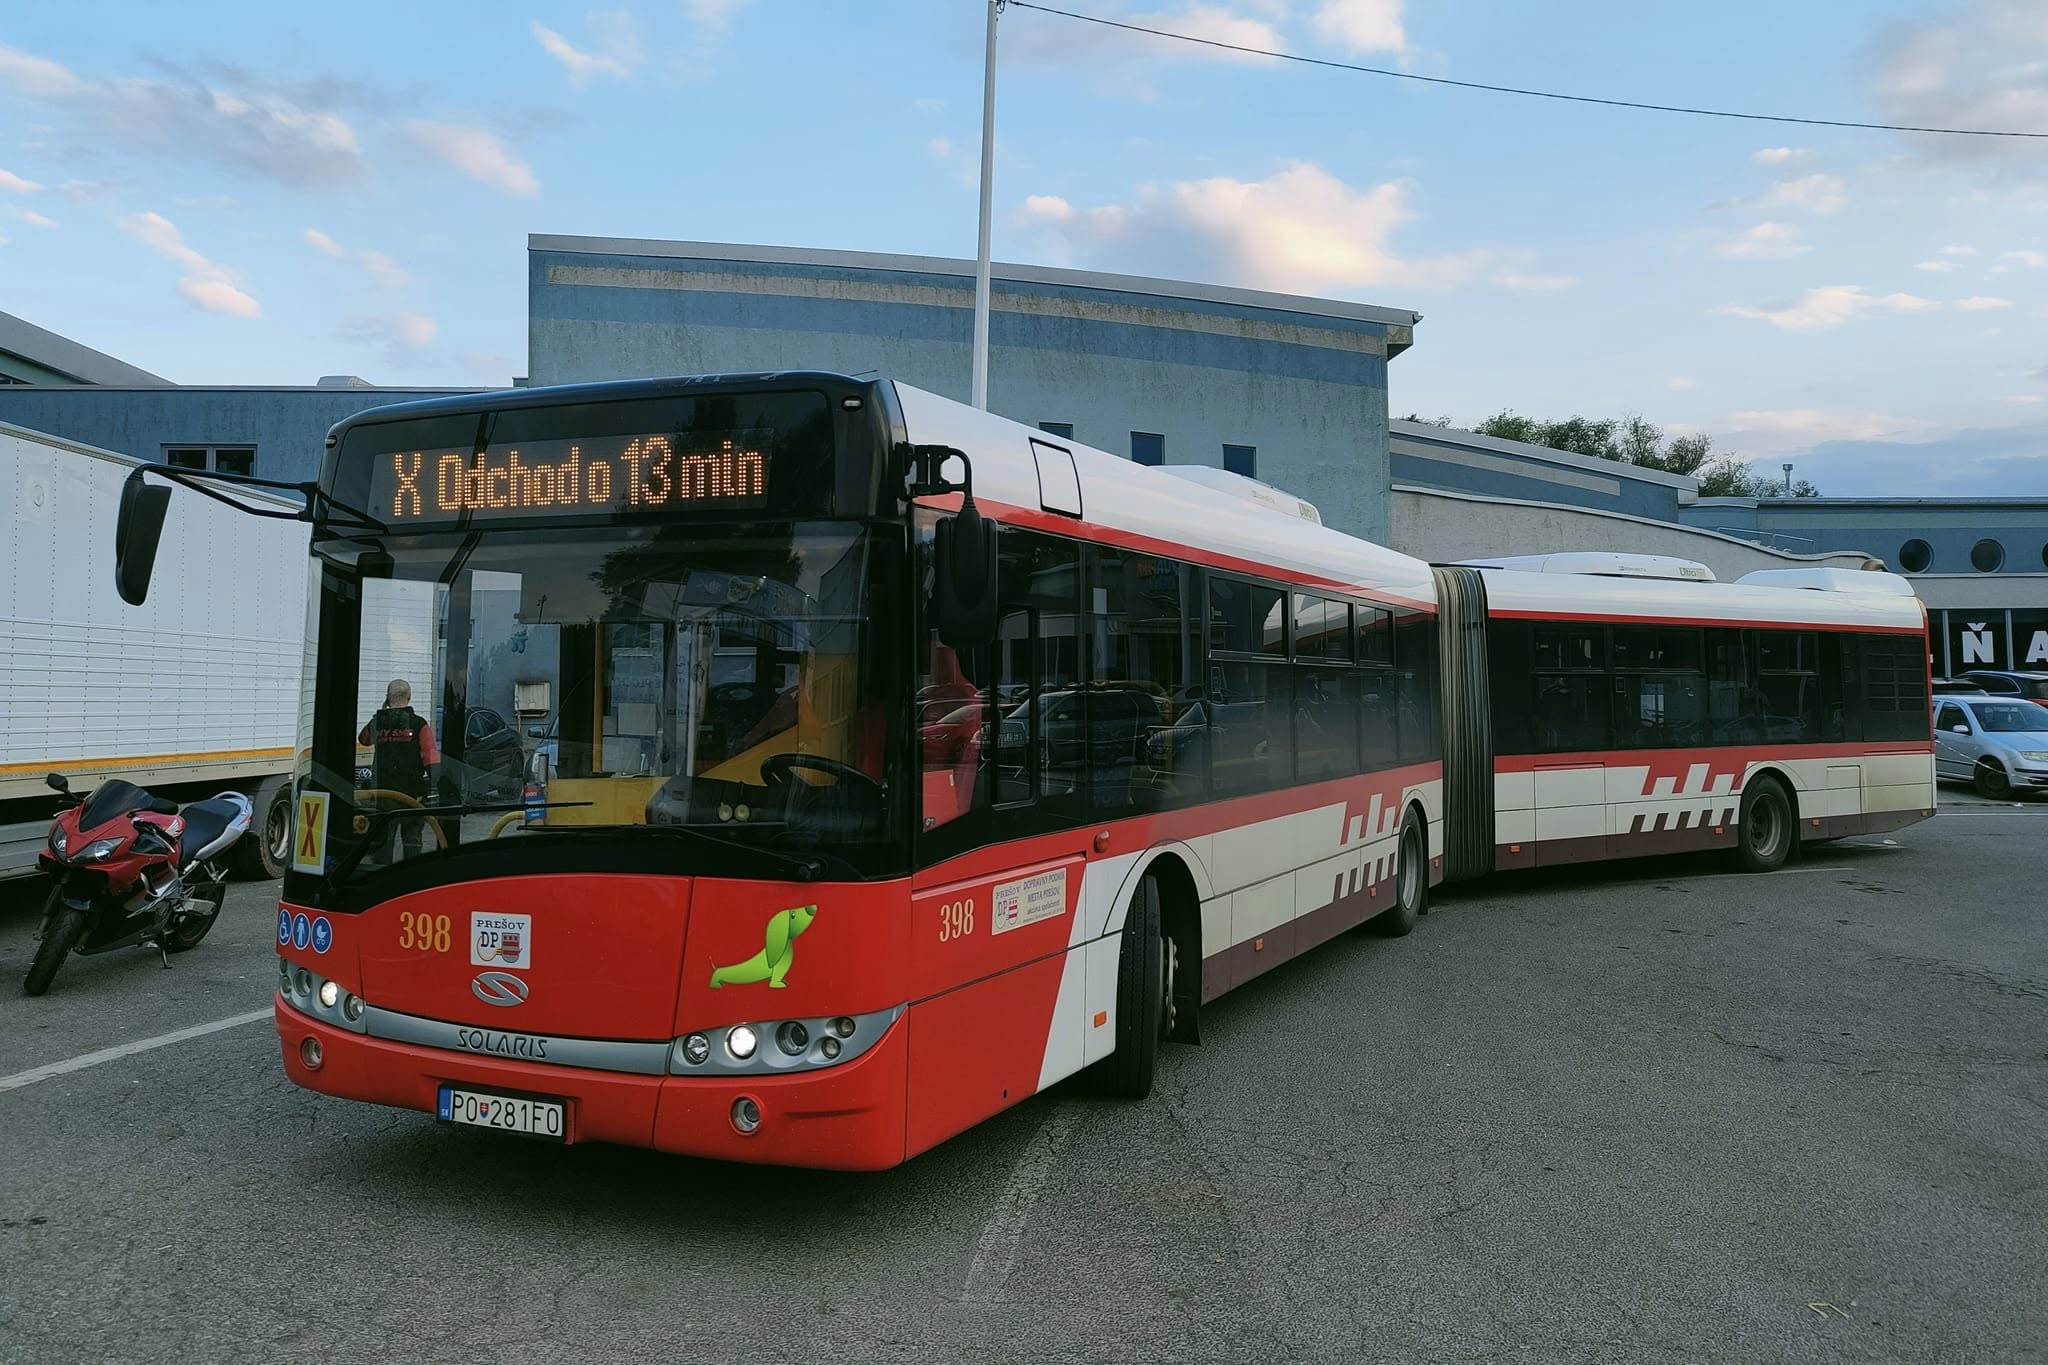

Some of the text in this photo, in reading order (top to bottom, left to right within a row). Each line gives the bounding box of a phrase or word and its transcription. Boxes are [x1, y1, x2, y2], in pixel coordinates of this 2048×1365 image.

[394, 435, 763, 516] X Odchod o 13 min
[300, 801, 321, 858] X
[399, 911, 451, 952] 398
[476, 918, 526, 930] PREŠOV
[480, 931, 499, 948] DP
[939, 898, 975, 942] 398
[457, 1029, 548, 1059] SOLARIS
